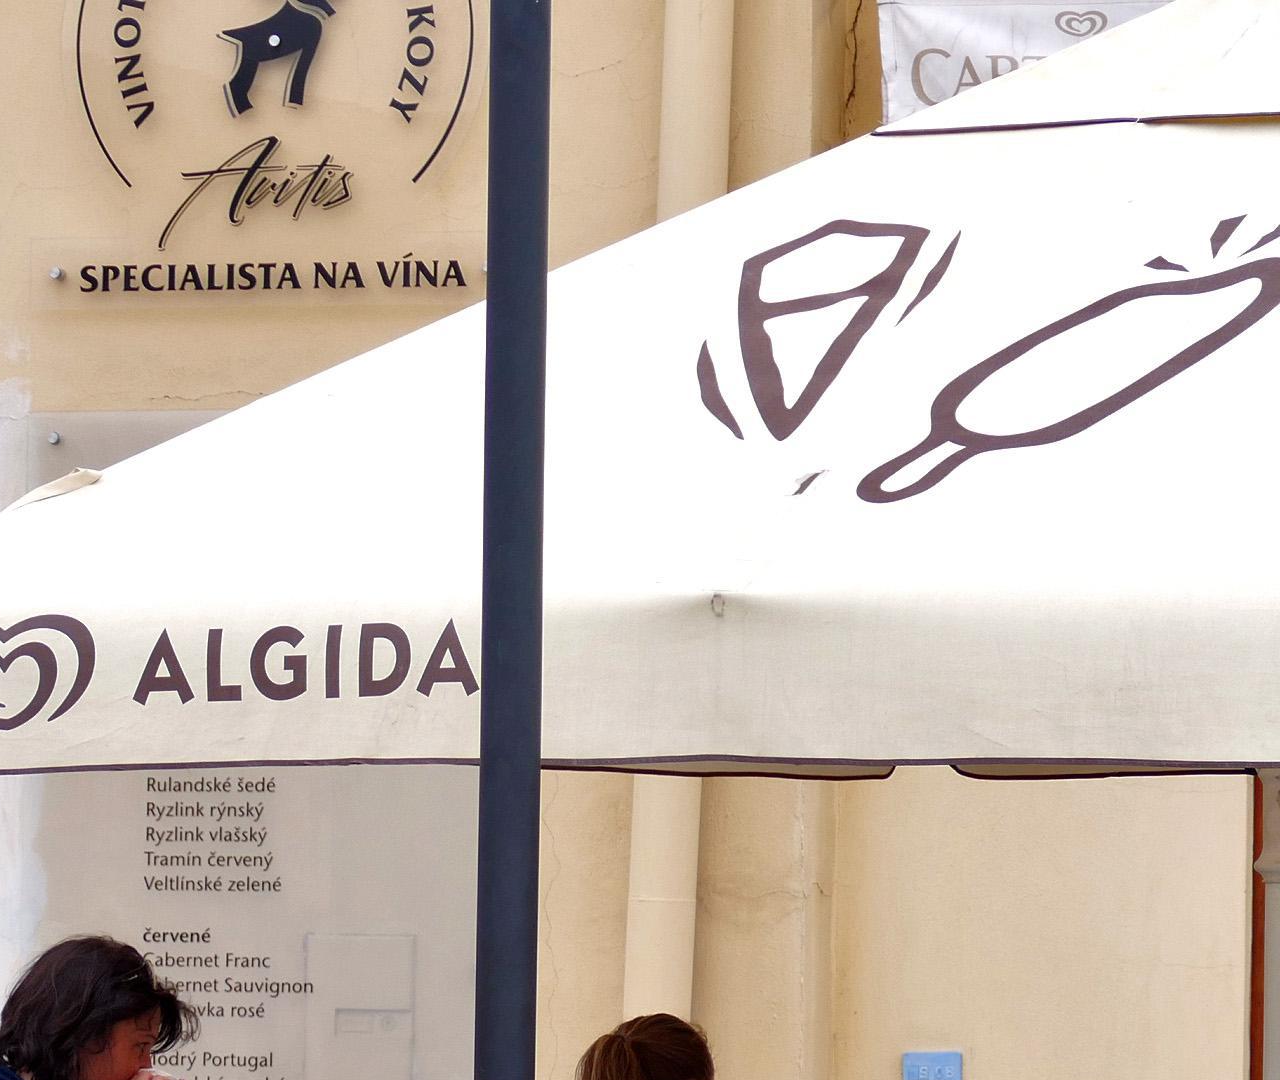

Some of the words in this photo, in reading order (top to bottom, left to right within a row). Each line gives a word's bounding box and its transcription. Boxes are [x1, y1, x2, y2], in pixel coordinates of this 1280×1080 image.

[389, 5, 437, 124] KOZY
[80, 263, 302, 292] SPECIALISTA
[313, 261, 365, 290] NA
[377, 253, 467, 288] VÍNA
[132, 617, 480, 705] ALGIDA
[146, 776, 231, 793] Rulandské
[237, 776, 276, 793] šedé
[146, 802, 204, 819] Ryzlink
[210, 802, 264, 821] rýnský
[146, 826, 204, 844] Ryzlink
[209, 826, 268, 846] vlašský
[144, 851, 202, 867] Tramín
[207, 851, 273, 871] červený
[144, 876, 222, 893] Veltlínské
[228, 876, 282, 893] zelené
[143, 927, 212, 943] červené
[225, 952, 271, 968] Franc
[224, 977, 314, 998] Sauvignon
[231, 1002, 265, 1018] rosé
[203, 1052, 273, 1072] Portugal
